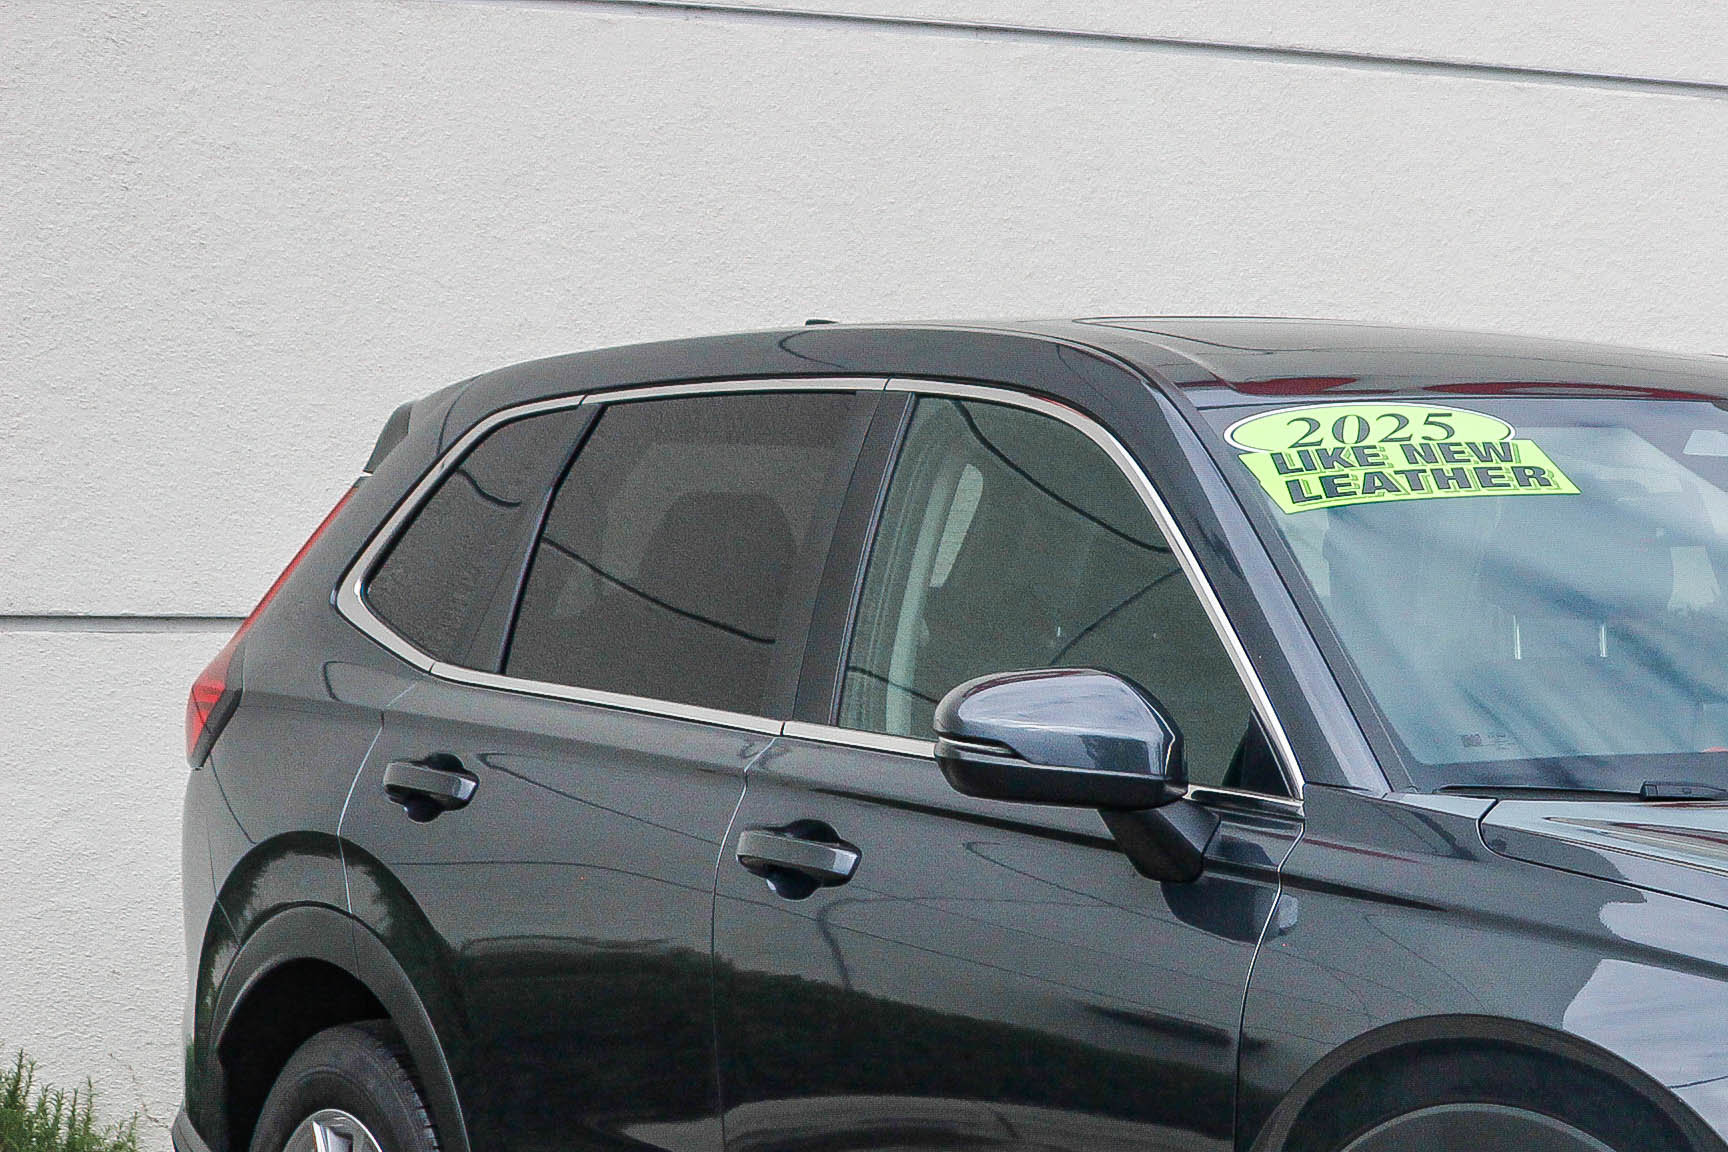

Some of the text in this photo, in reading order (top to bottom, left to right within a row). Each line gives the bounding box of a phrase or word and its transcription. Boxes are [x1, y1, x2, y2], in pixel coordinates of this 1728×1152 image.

[1286, 413, 1456, 448] 2025
[1271, 441, 1519, 475] LIKE NEW
[1286, 465, 1561, 504] LEATHER
